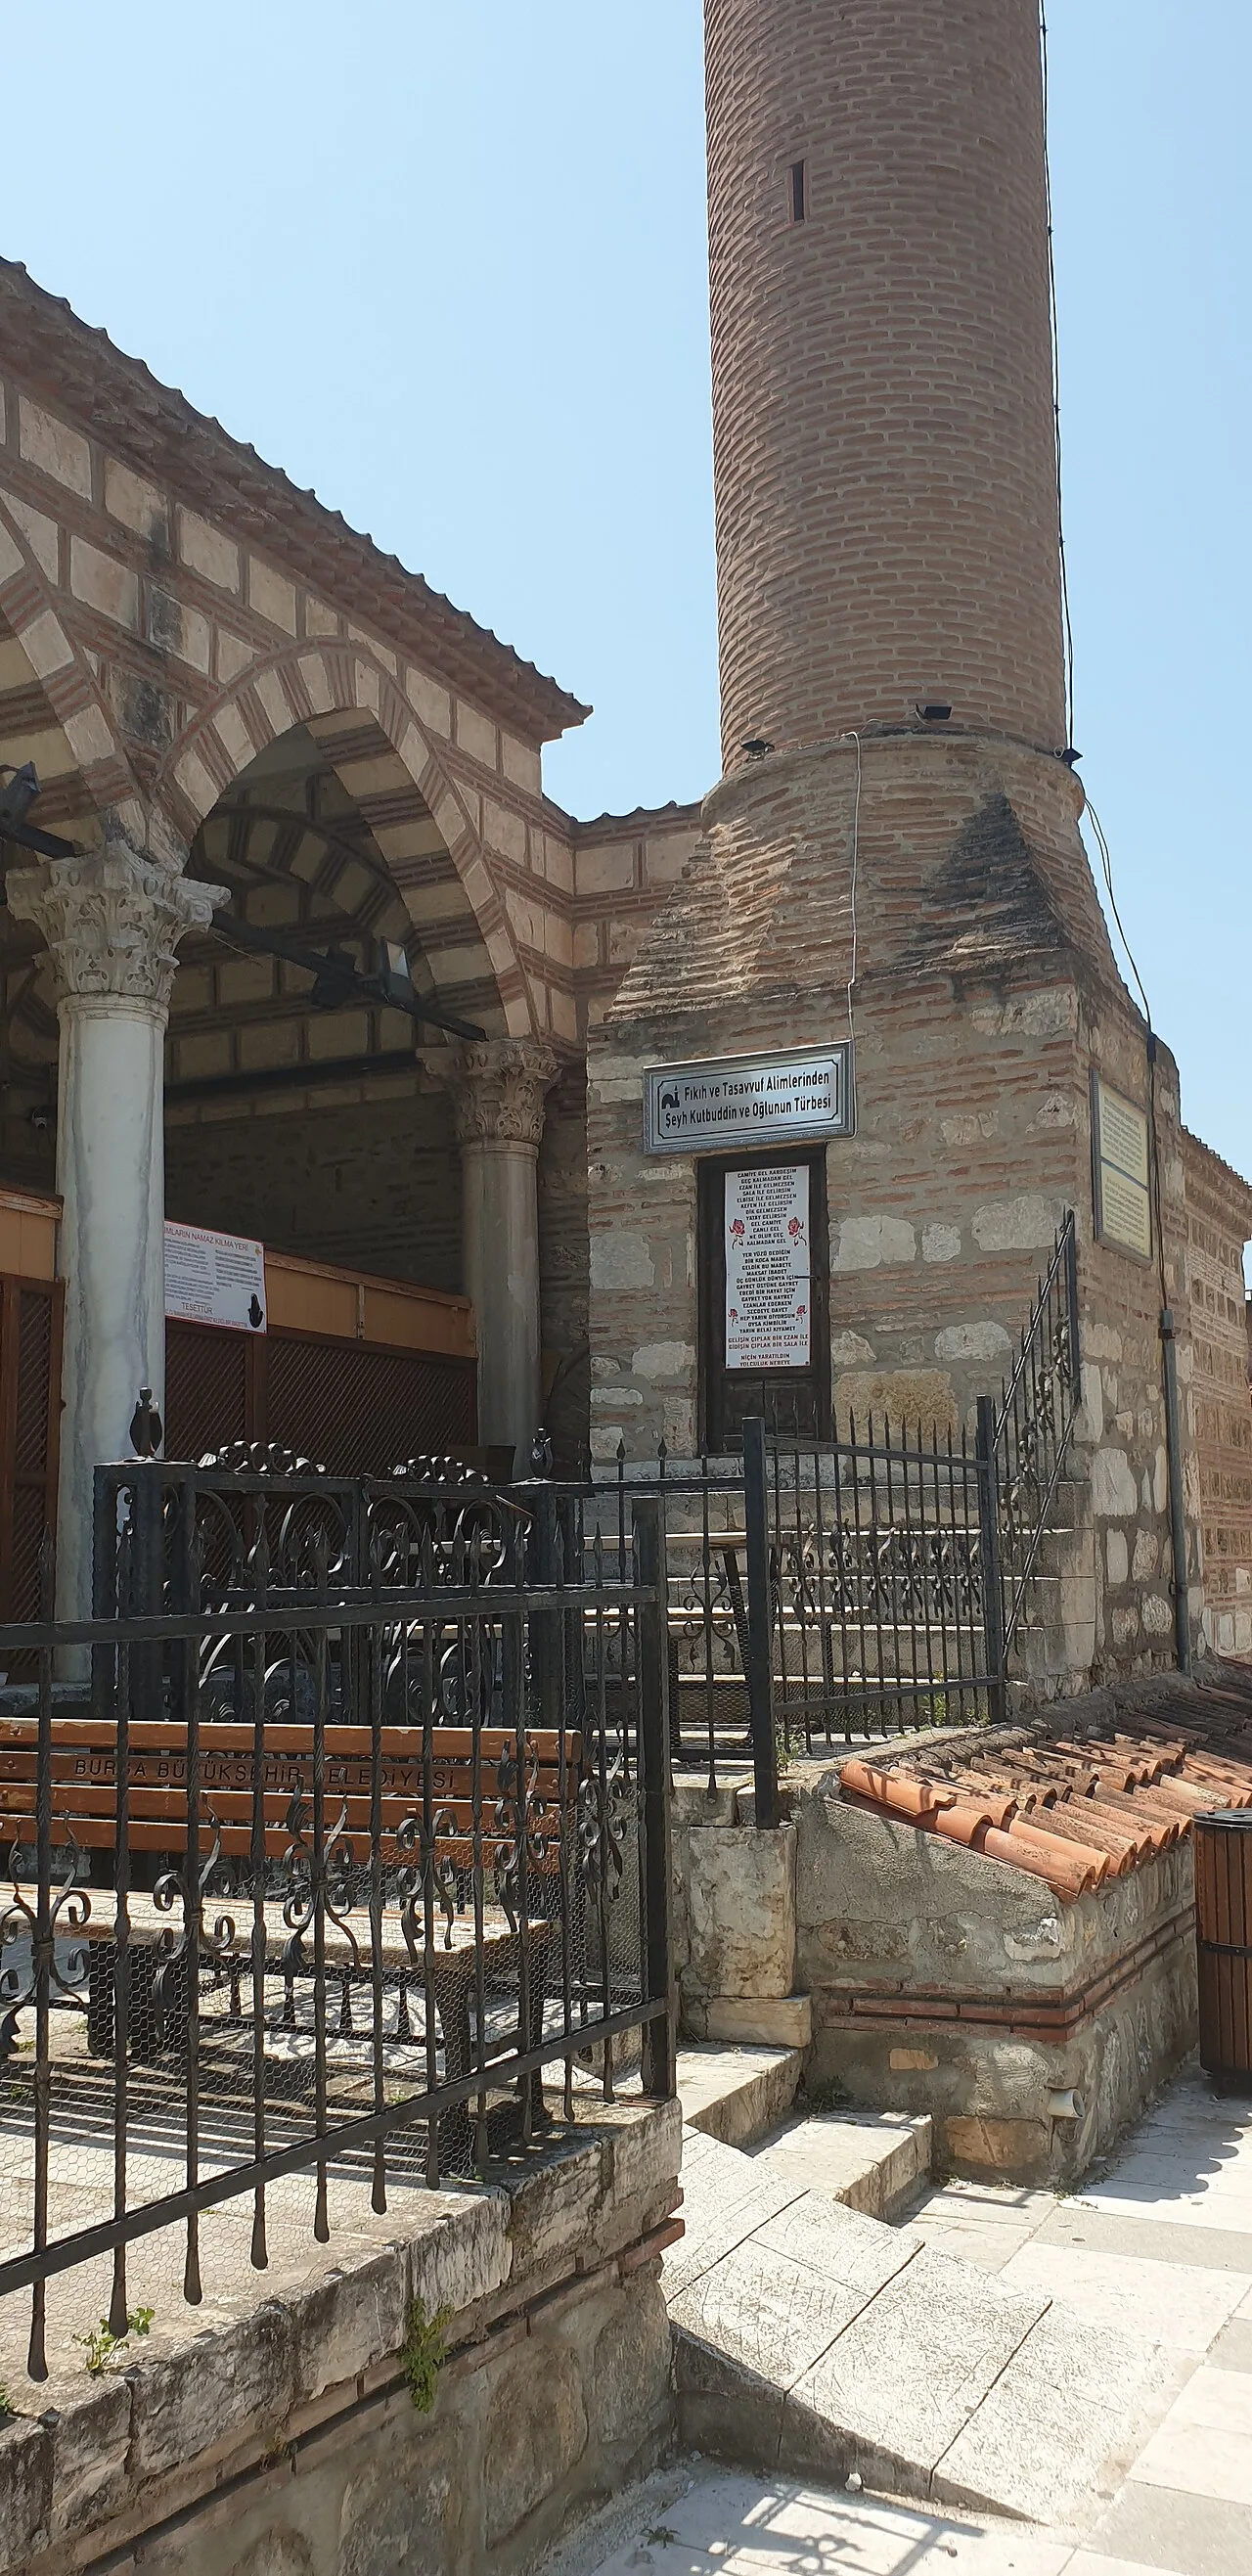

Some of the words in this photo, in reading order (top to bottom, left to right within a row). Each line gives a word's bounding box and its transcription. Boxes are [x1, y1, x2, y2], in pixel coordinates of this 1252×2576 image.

[685, 1085, 706, 1102] Fıkıh
[710, 1088, 720, 1098] ve
[723, 1080, 764, 1097] Tasavvuf
[767, 1071, 828, 1091] Alimlerinden
[666, 1112, 687, 1129] Şeyh
[691, 1106, 737, 1124] Kutbuddin
[739, 1108, 749, 1118] ve
[753, 1101, 791, 1119] Oğlunun
[794, 1094, 830, 1111] Türbesi
[164, 1227, 191, 1239] IMLARIN
[192, 1233, 214, 1243] NAMAZ
[74, 1759, 146, 1778] BURA
[157, 1759, 301, 1783] BÜÜKŞHİR
[328, 1765, 455, 1789] ELEDİYESİ
